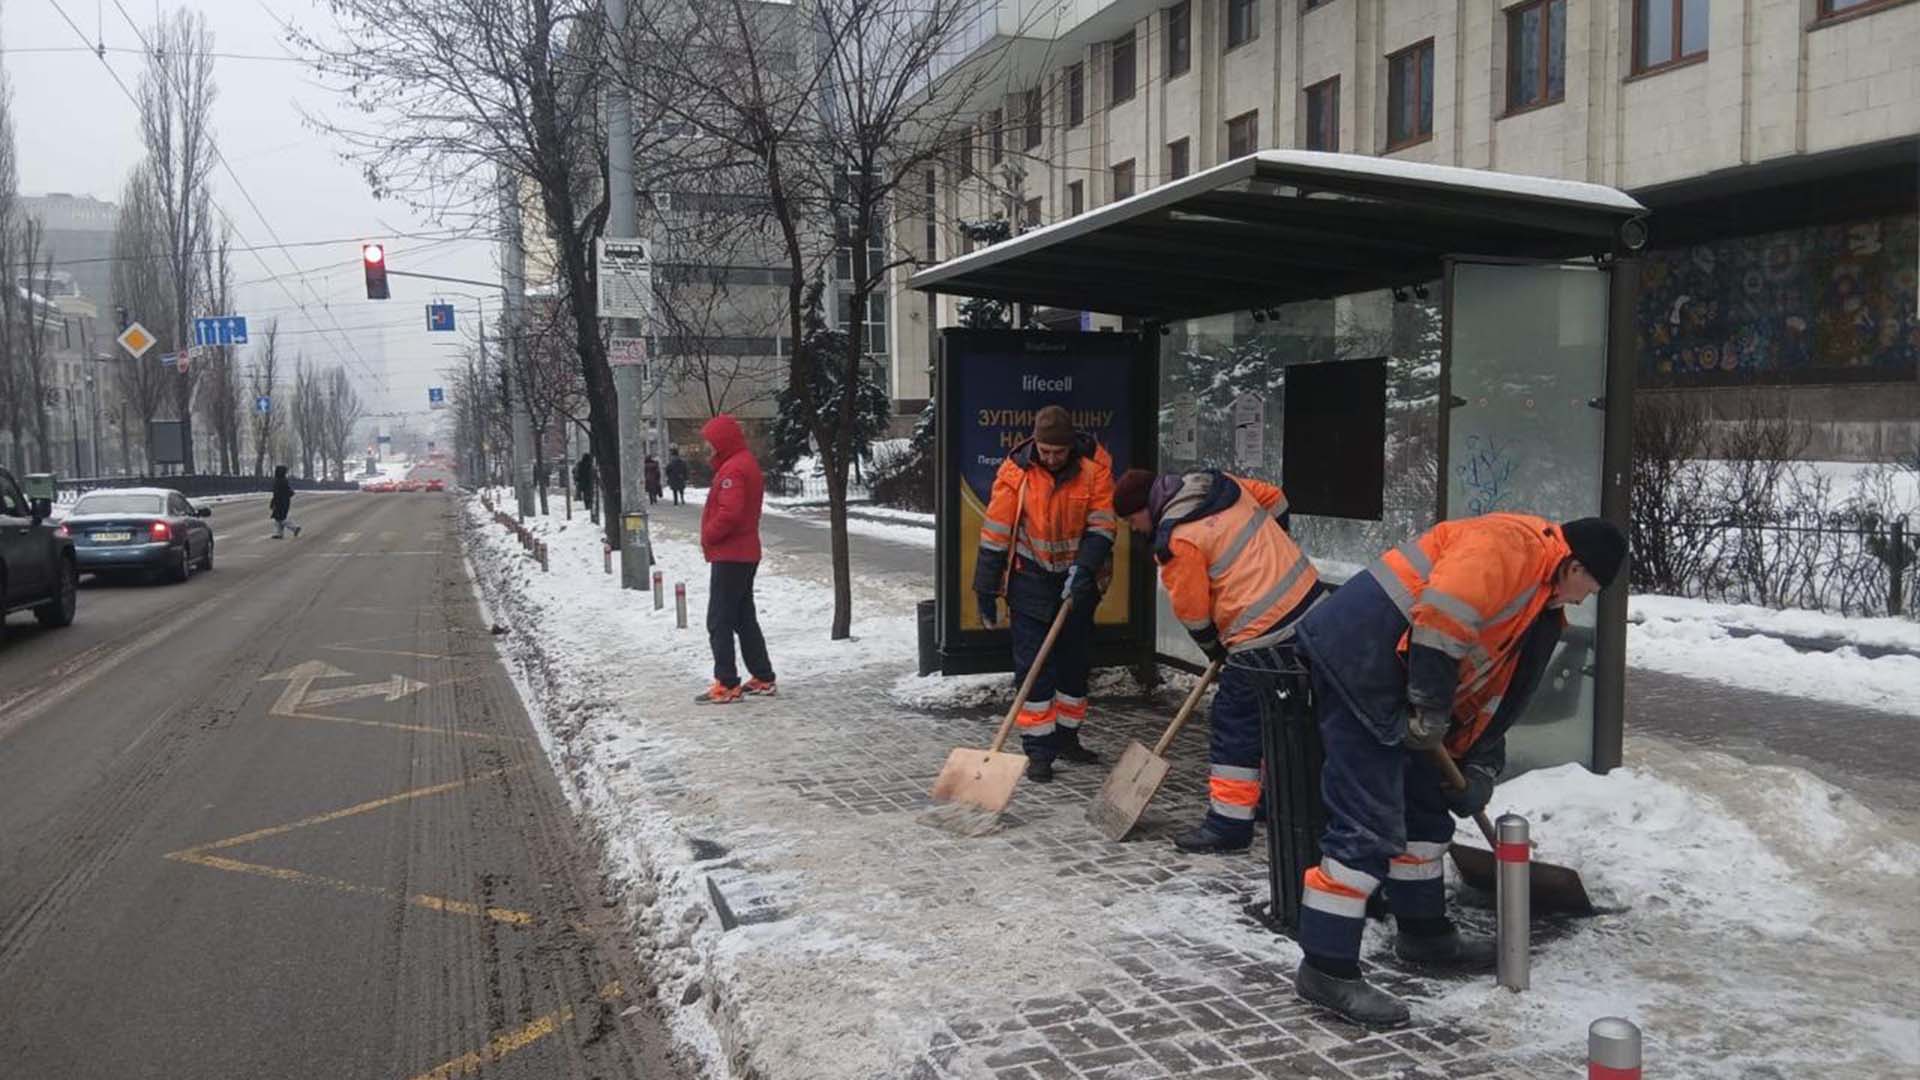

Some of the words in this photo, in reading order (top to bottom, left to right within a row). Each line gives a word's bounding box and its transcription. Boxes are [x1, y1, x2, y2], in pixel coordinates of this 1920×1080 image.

[1022, 374, 1073, 391] lifecell
[978, 409, 1041, 427] ЗУПИН
[1071, 409, 1114, 428] ЦІНУ
[977, 455, 1003, 466] Пере
